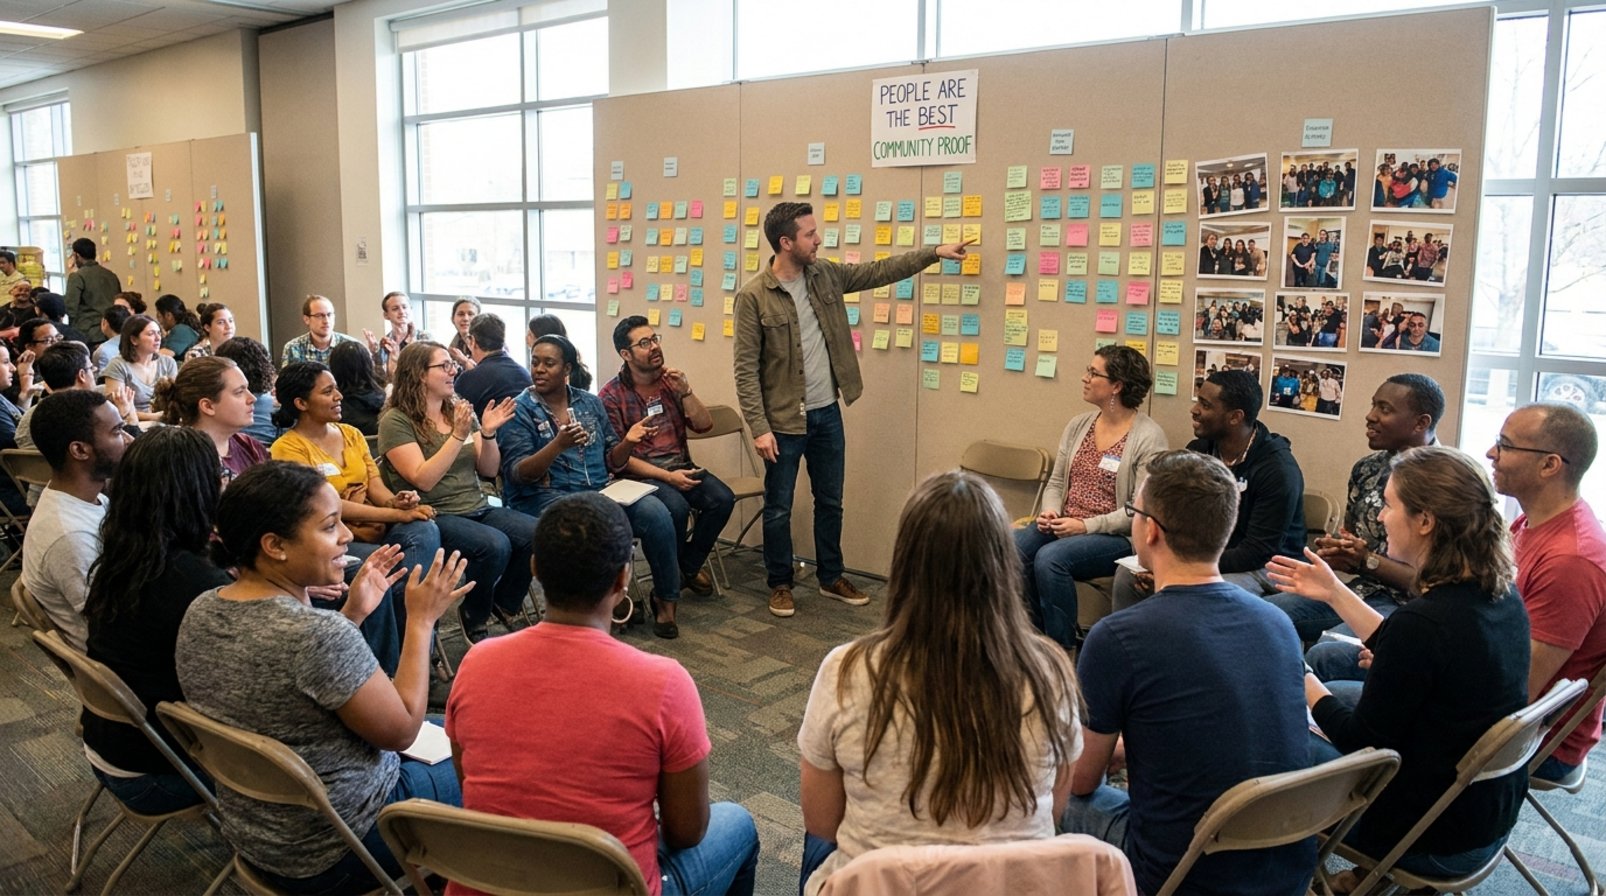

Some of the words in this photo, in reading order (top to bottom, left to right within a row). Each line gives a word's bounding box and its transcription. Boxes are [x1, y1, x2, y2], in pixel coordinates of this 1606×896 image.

[880, 81, 931, 105] PEOPLE
[937, 78, 967, 99] ARE
[886, 109, 911, 128] THE
[918, 104, 958, 126] BEST
[873, 138, 934, 160] COMMUNITY
[937, 135, 973, 156] PROOF
